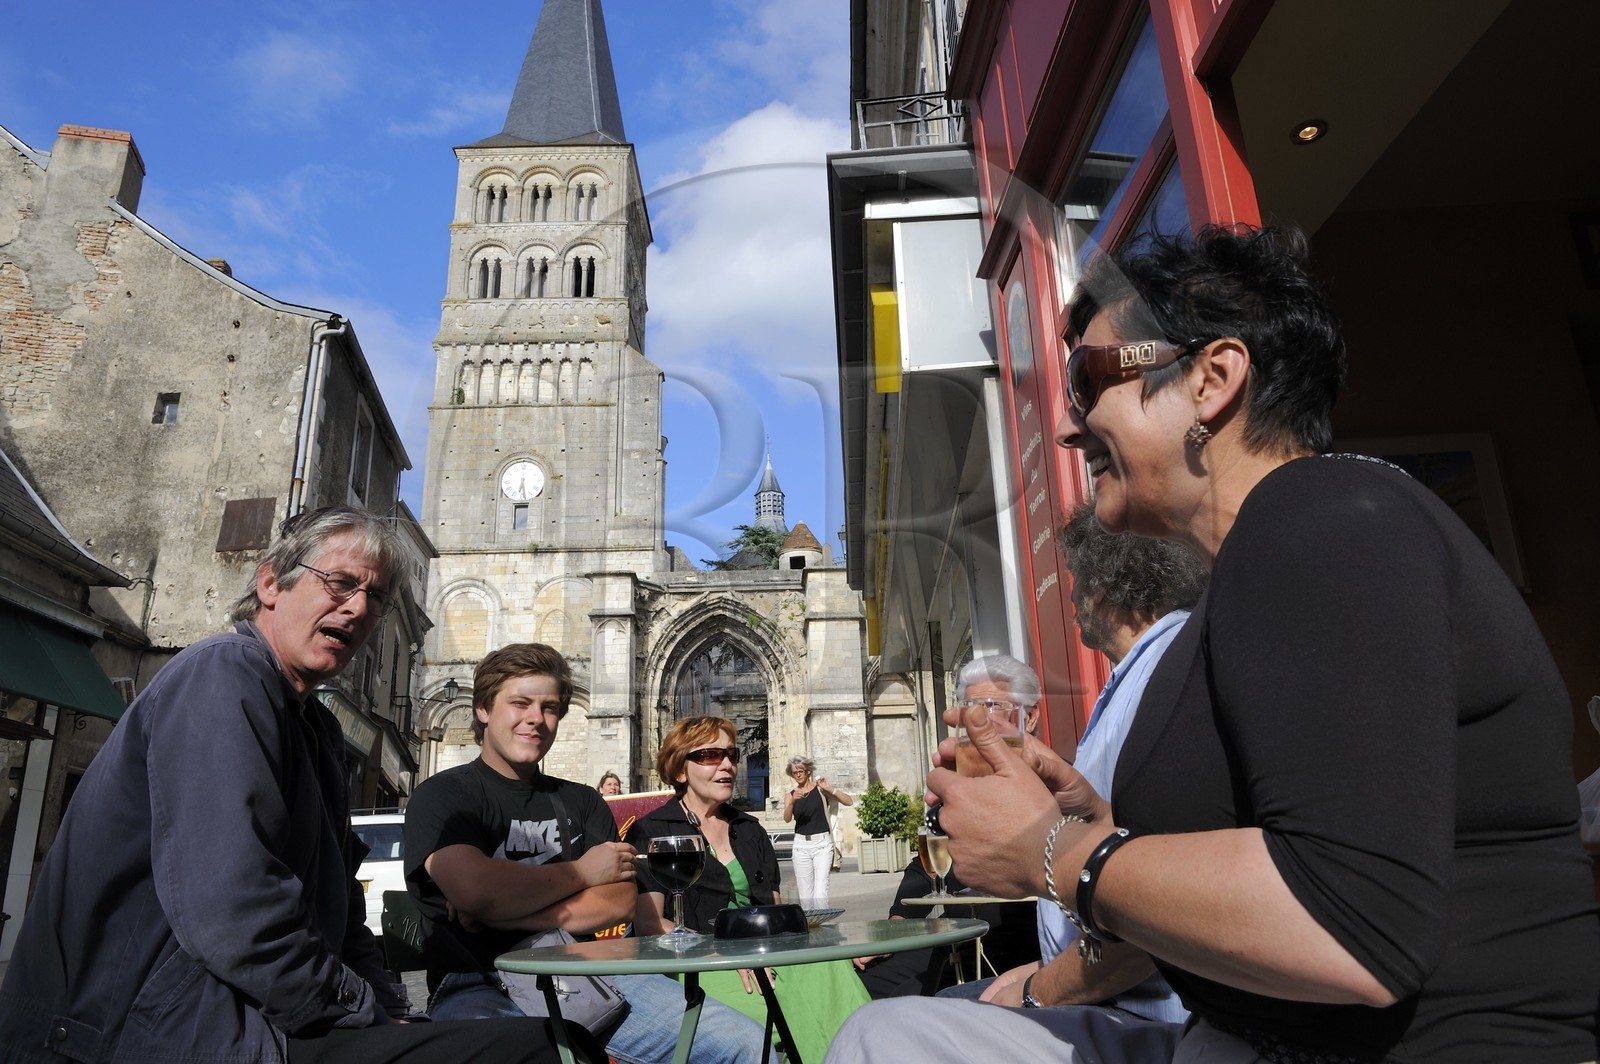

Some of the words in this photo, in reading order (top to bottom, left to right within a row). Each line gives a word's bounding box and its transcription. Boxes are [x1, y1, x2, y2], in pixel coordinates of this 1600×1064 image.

[1021, 399, 1032, 421] Vins
[1021, 431, 1042, 468] Produits
[1030, 467, 1038, 484] du
[1029, 487, 1046, 516] Terroir
[1033, 526, 1051, 554] Galerie
[1035, 572, 1057, 602] Cadeaux
[506, 819, 563, 854] NIKE
